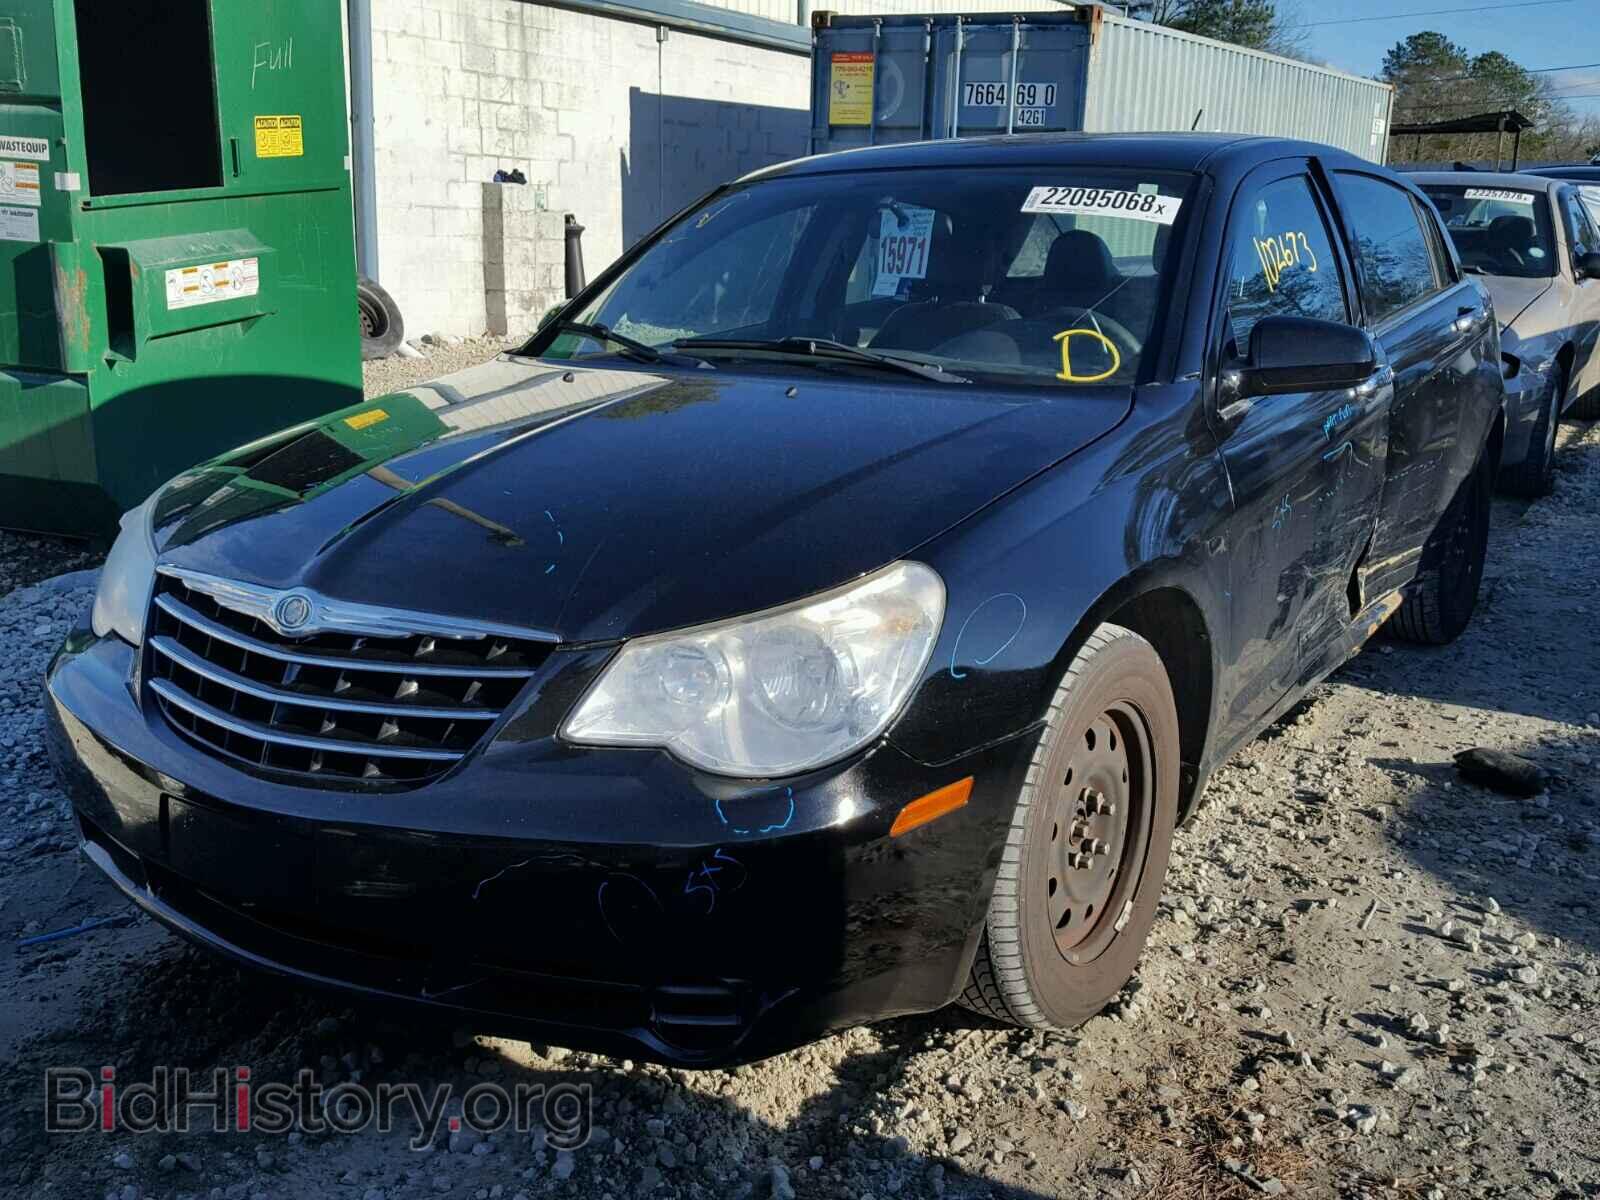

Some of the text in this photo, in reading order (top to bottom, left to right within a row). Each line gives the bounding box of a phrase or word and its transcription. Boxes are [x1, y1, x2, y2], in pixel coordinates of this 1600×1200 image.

[251, 37, 293, 90] Full
[1045, 84, 1055, 106] 0
[1041, 187, 1156, 212] 22095068
[881, 235, 926, 275] 15971
[1253, 231, 1317, 293] 102673
[1052, 329, 1121, 382] D
